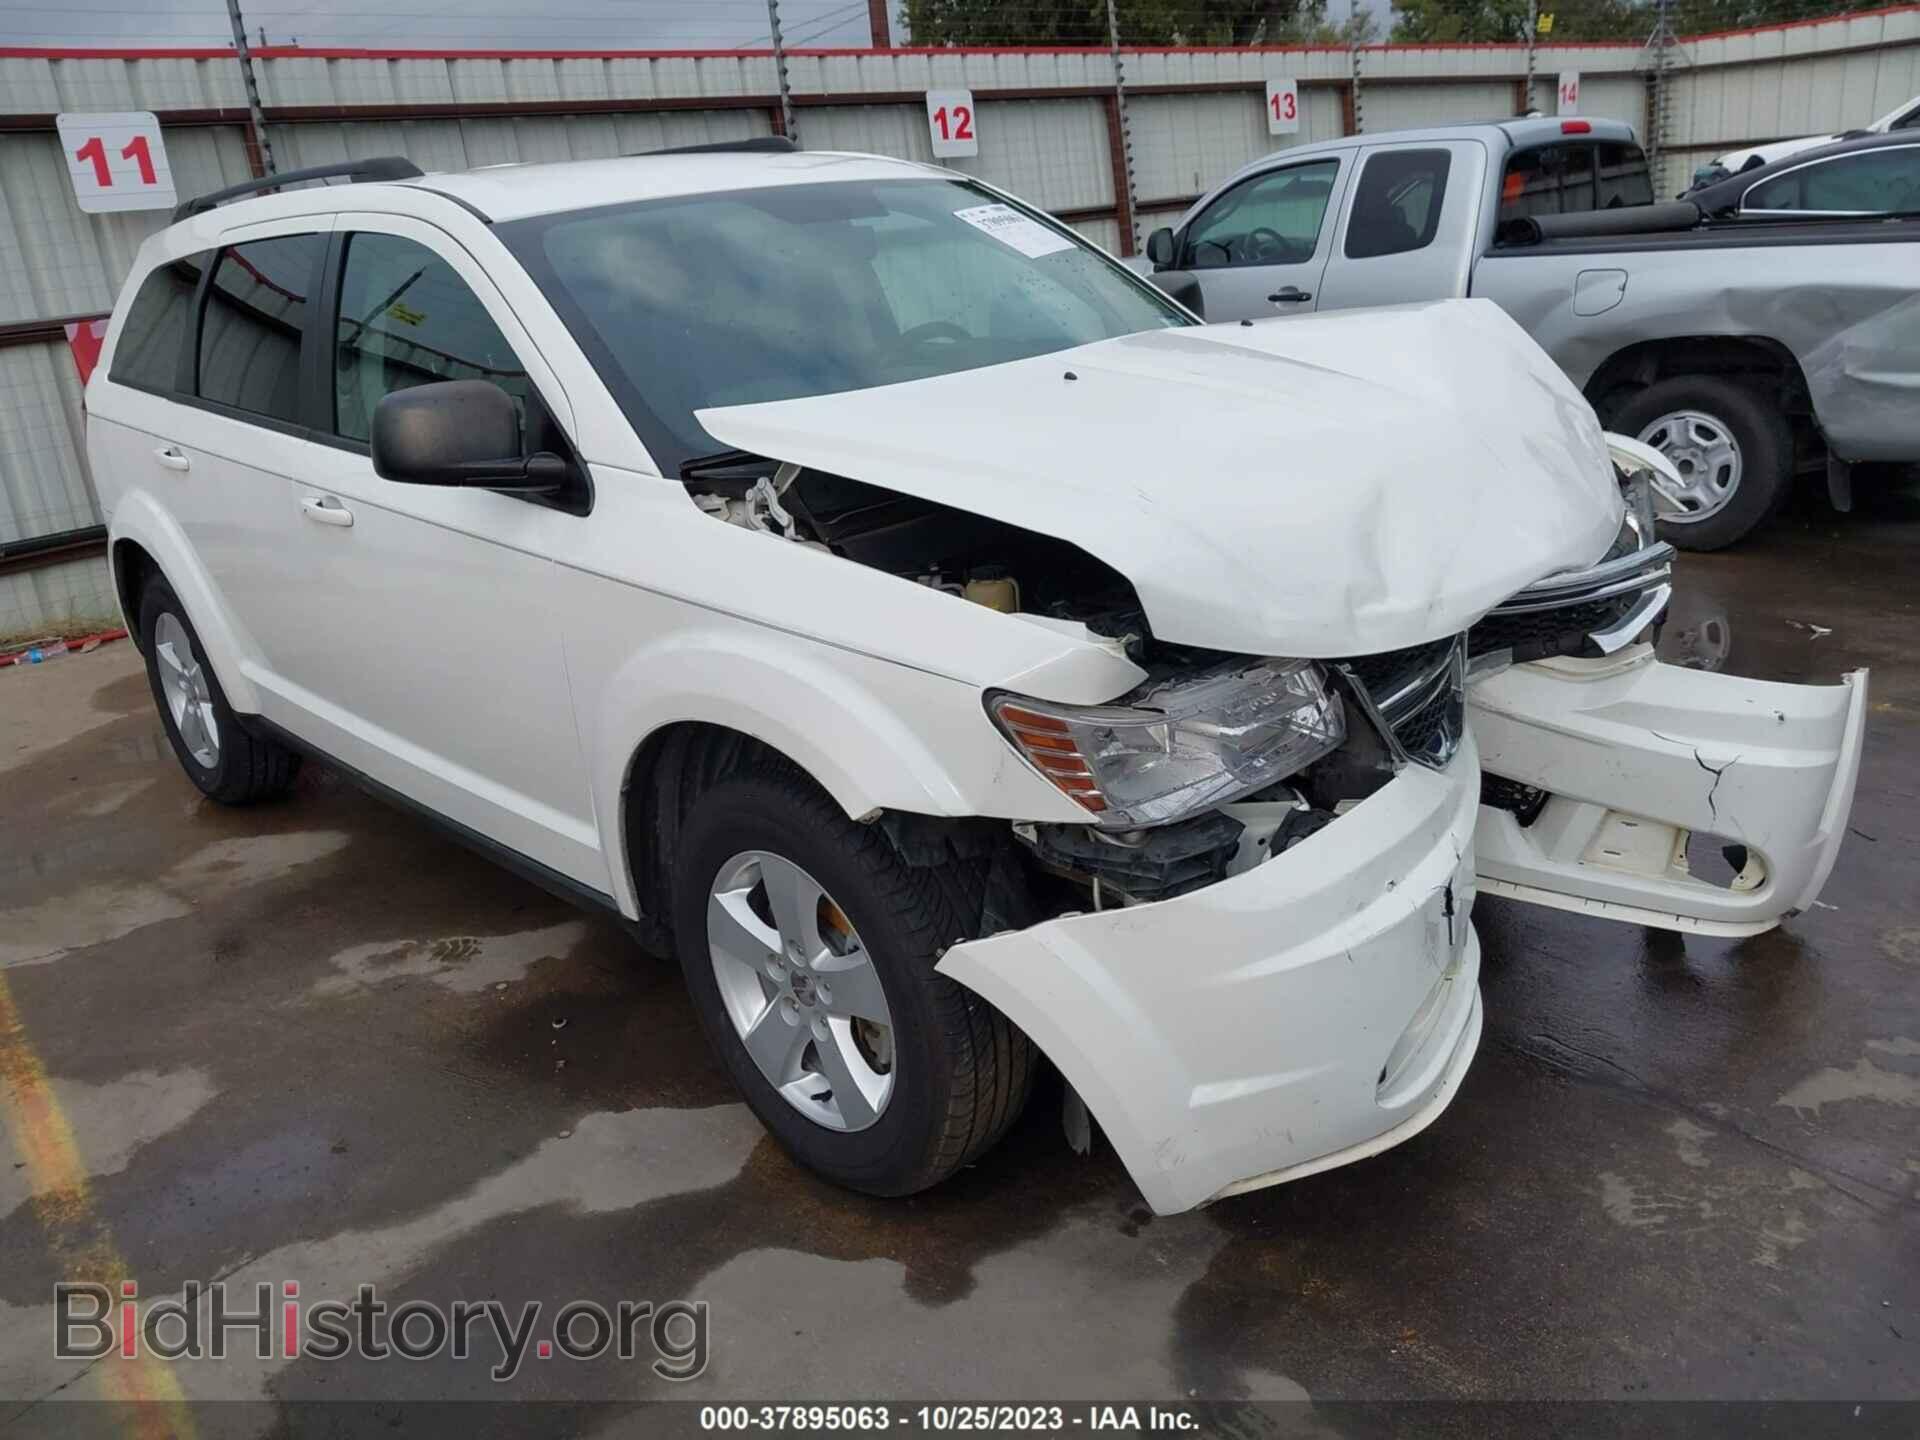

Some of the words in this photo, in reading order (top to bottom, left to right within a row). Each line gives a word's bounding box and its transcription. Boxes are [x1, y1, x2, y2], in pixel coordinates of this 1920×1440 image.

[1269, 92, 1296, 120] 13
[1560, 82, 1577, 105] 14
[933, 106, 973, 141] 12
[76, 135, 158, 188] 11
